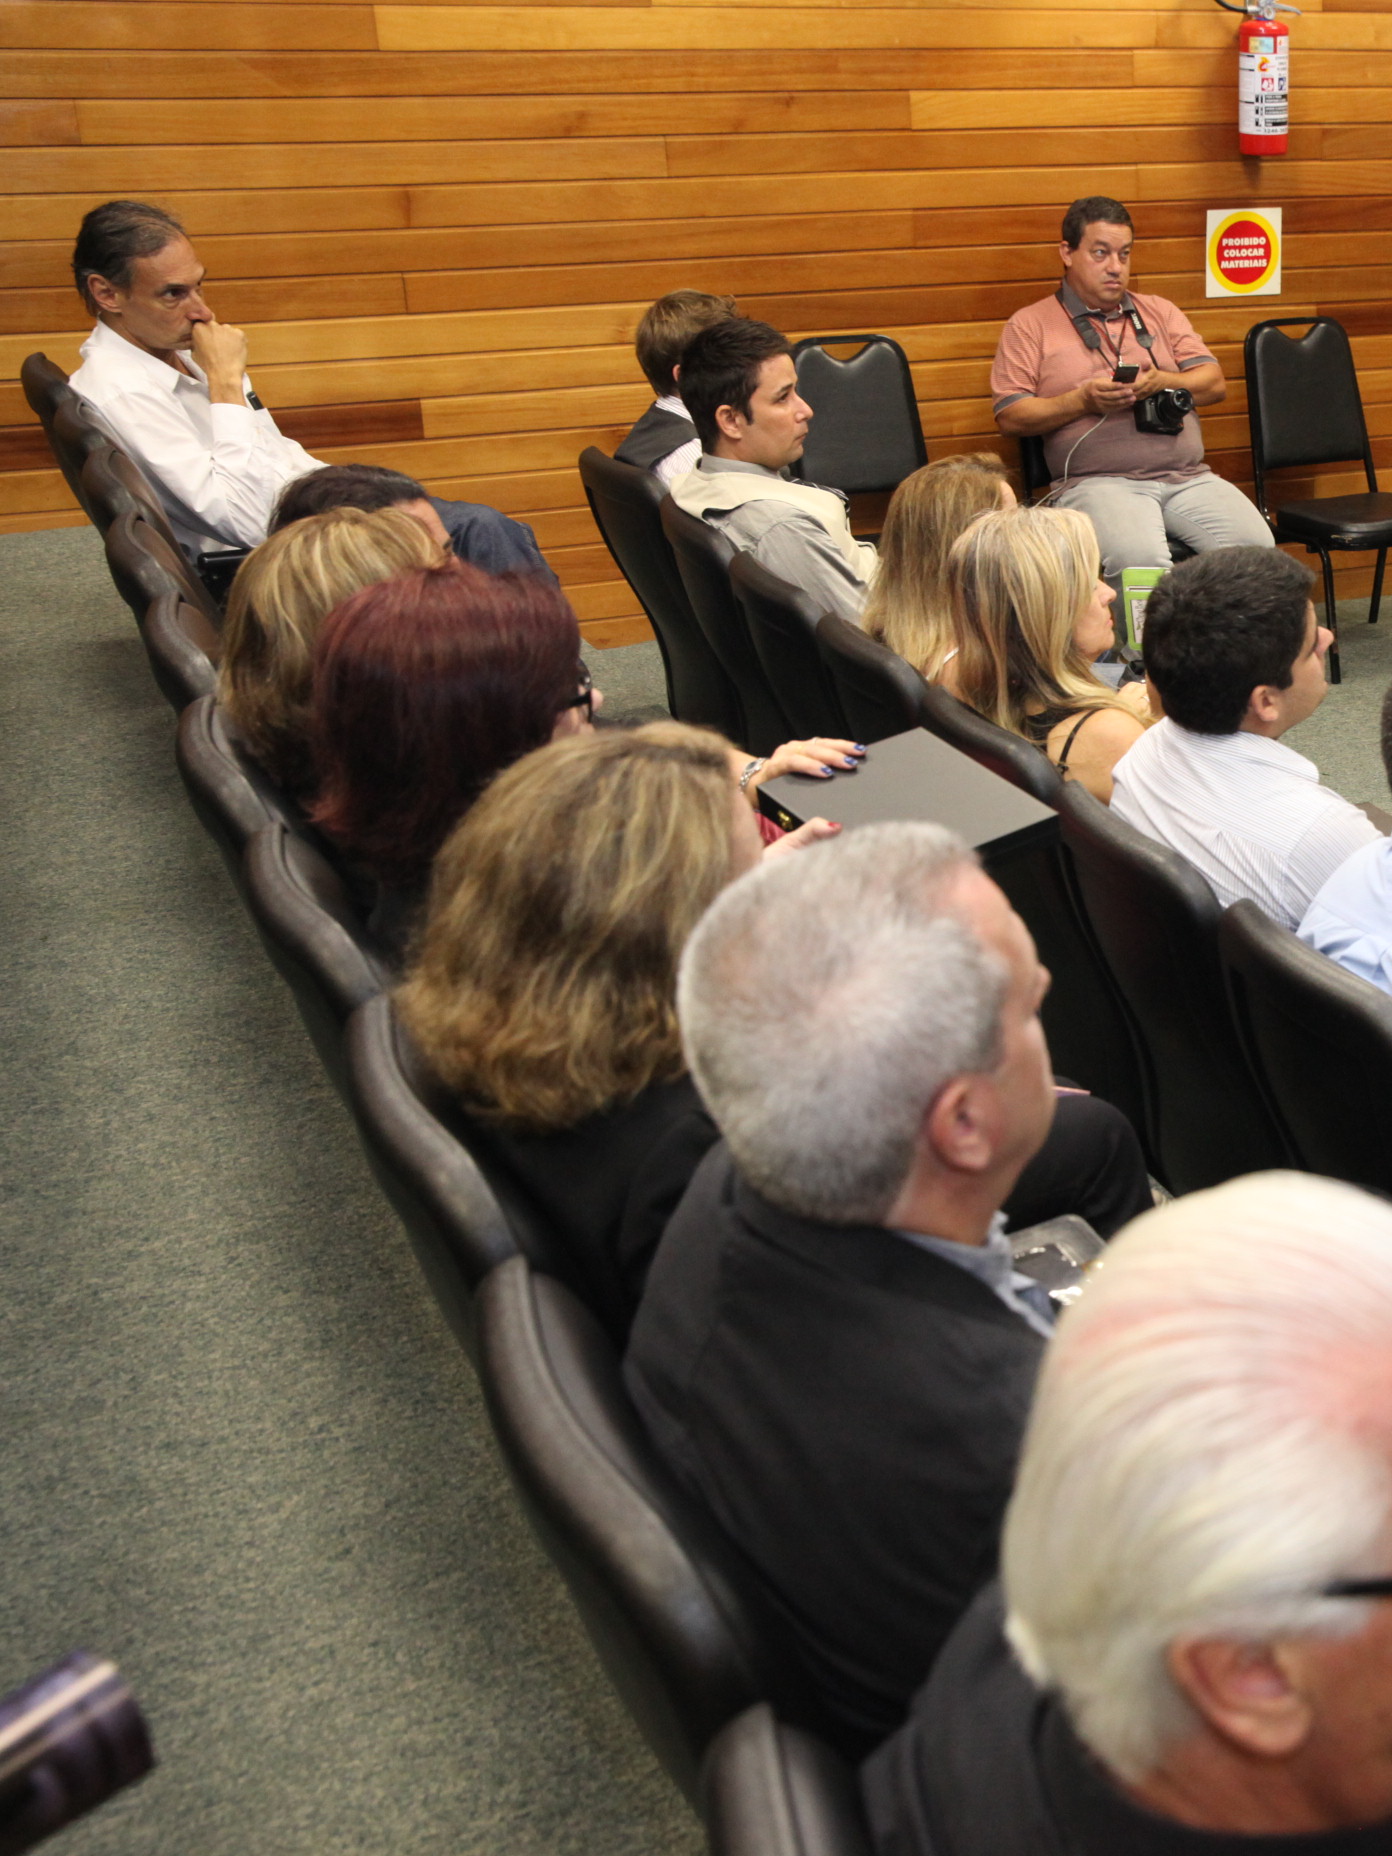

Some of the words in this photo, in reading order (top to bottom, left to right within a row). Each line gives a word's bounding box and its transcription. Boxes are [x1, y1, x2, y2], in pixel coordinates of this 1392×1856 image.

[1222, 237, 1266, 247] PROIBIDO
[1223, 248, 1265, 258] COLOCAR
[1220, 259, 1267, 269] MATERIAIS
